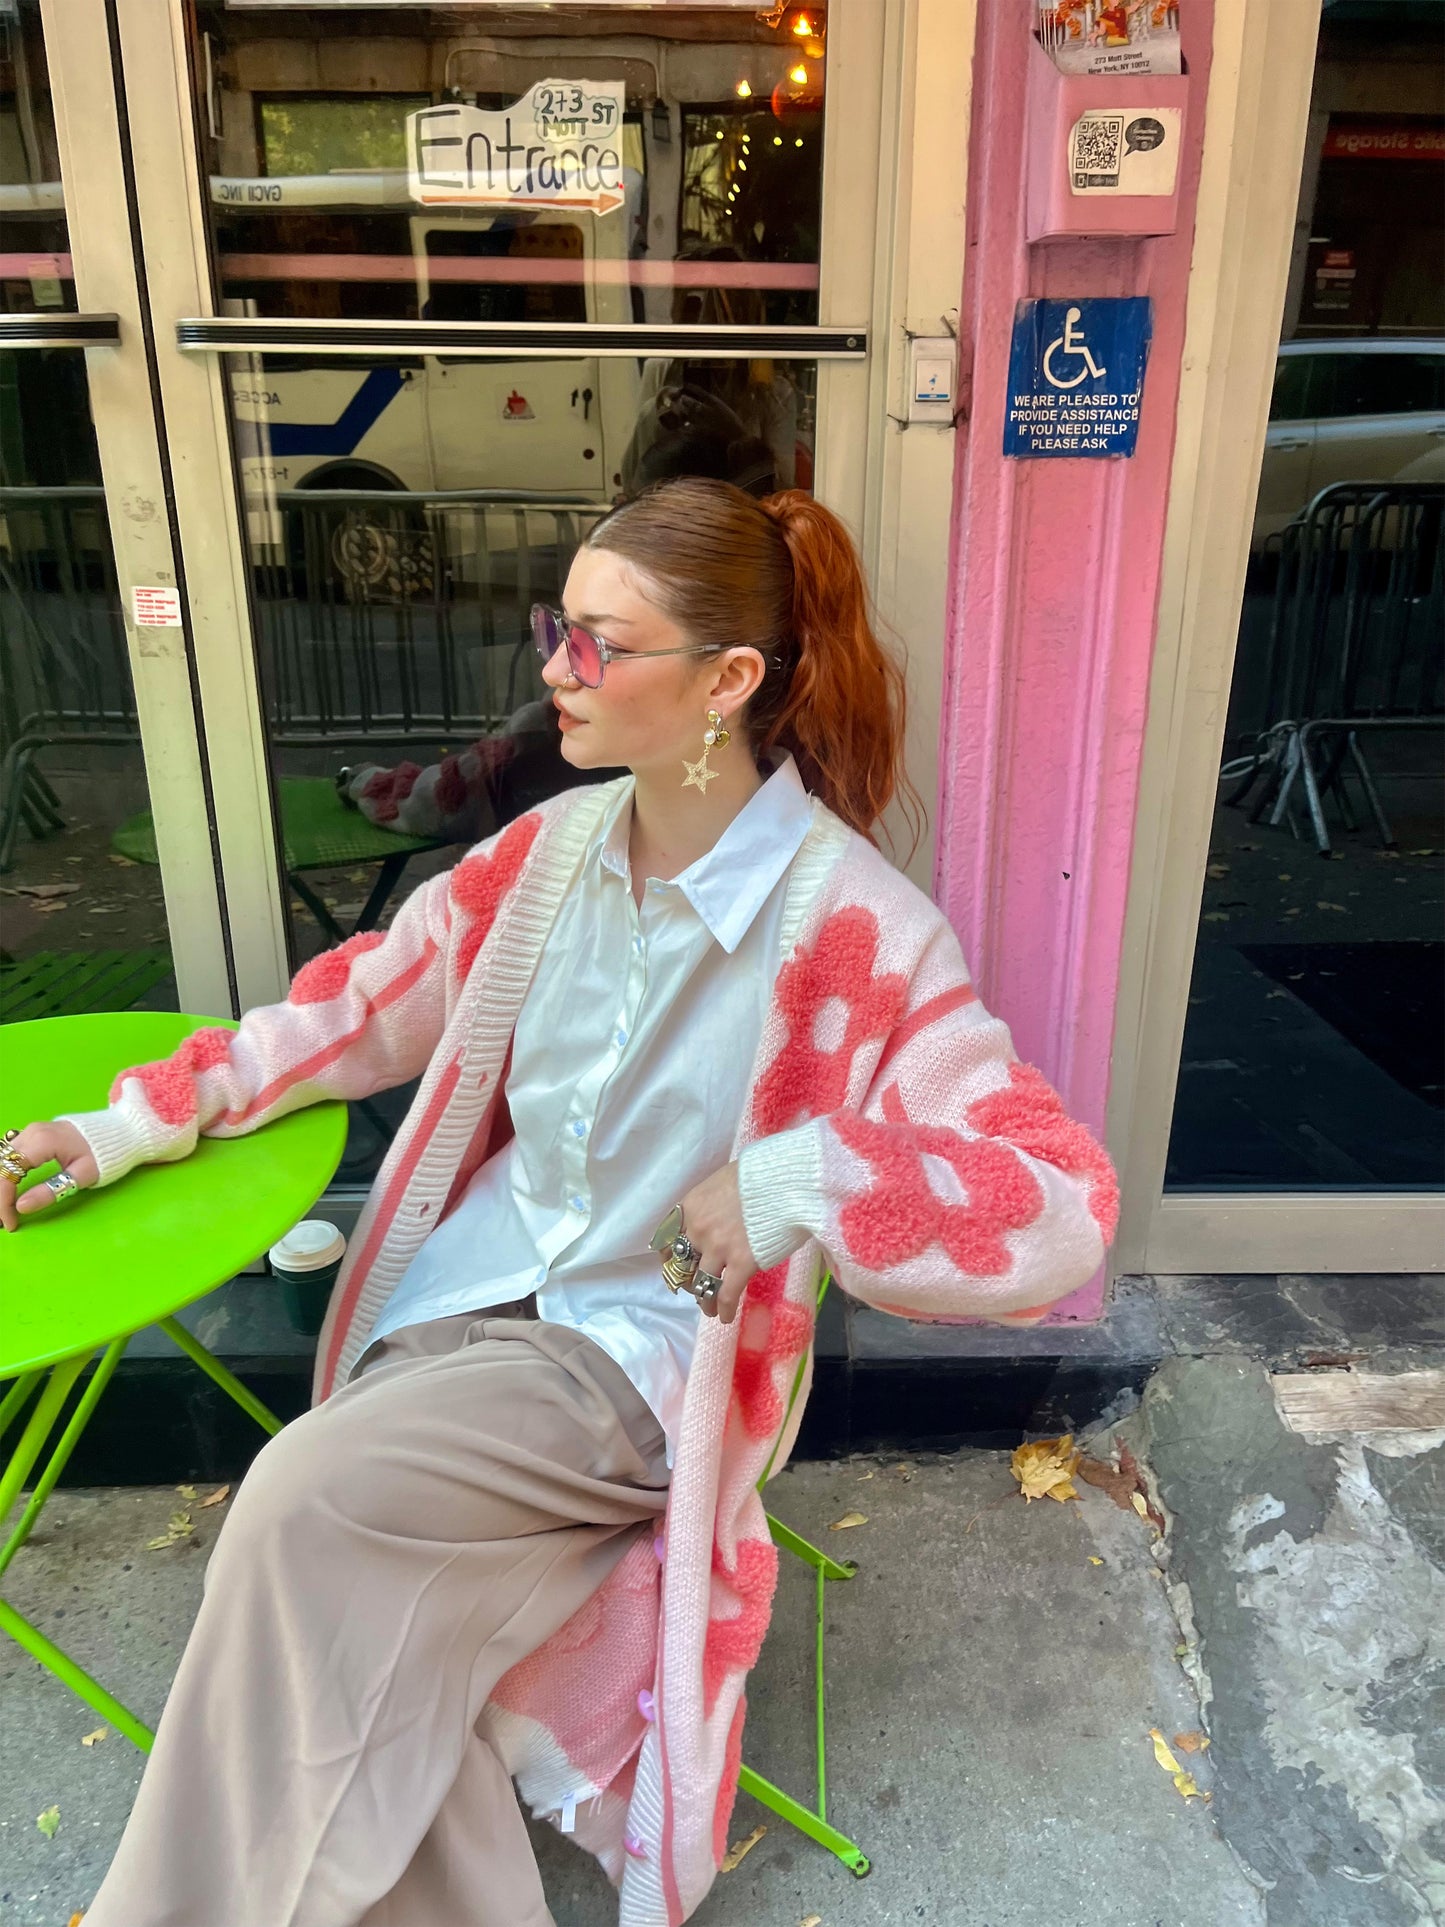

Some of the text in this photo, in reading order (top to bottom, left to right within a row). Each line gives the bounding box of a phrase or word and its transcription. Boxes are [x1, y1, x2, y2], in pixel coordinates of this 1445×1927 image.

[1094, 57, 1107, 65] 273
[1123, 52, 1143, 60] Street
[1131, 60, 1150, 69] 10012
[540, 89, 583, 115] 273
[591, 102, 615, 125] ST
[415, 109, 620, 193] Entrance
[1014, 394, 1138, 407] WE ARE PLEASED TO
[1010, 408, 1139, 422] PROVIDE ASSISTANCE
[1018, 423, 1128, 436] IF YOU NEED HELP
[1031, 438, 1108, 450] PLEASE ASK
